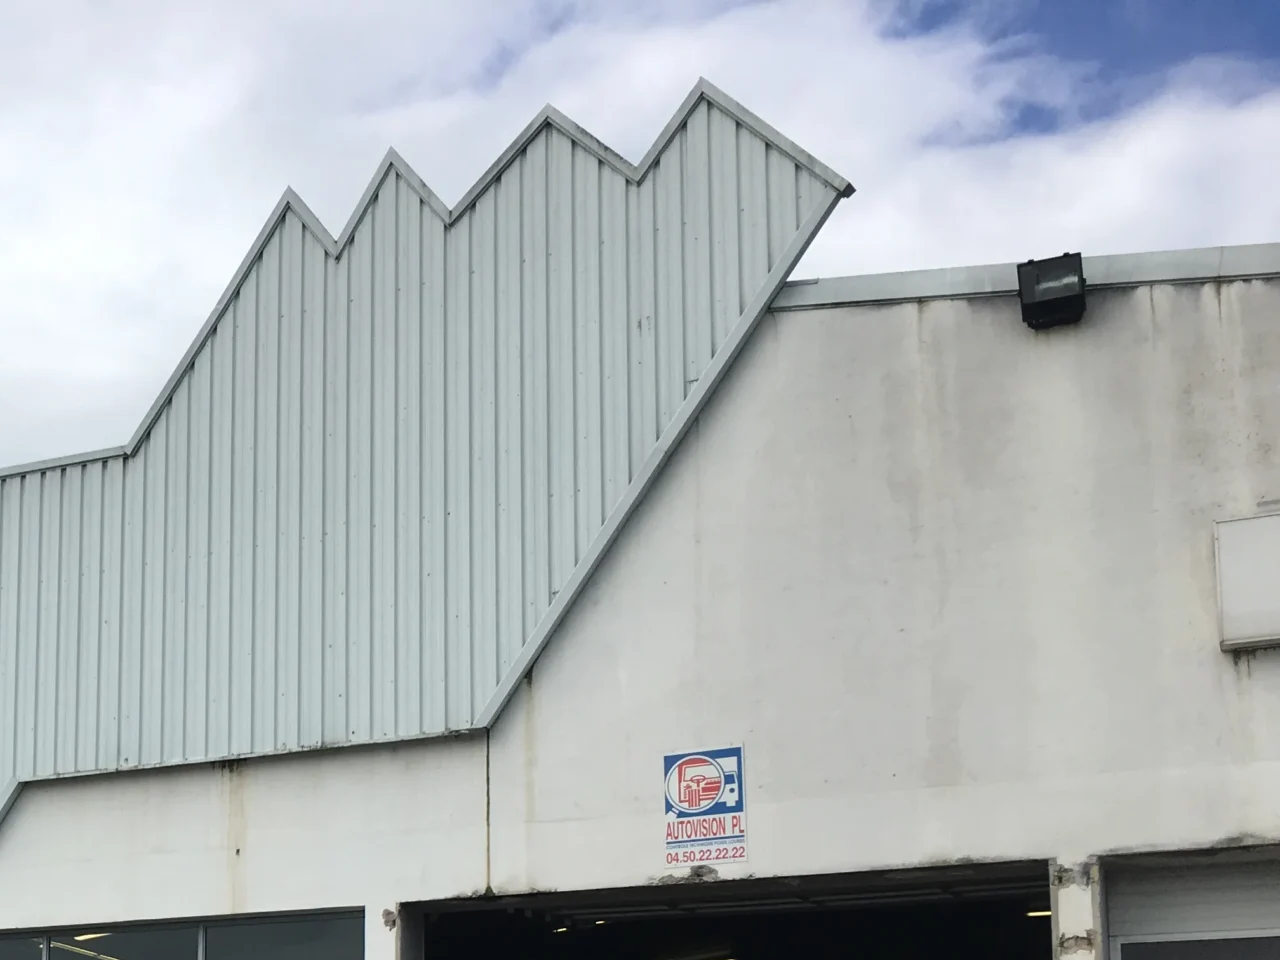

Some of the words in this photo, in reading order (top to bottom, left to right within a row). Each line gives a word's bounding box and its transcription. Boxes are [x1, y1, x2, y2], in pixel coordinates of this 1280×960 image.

[666, 816, 726, 840] AUTOVISION
[731, 815, 745, 834] PL
[666, 846, 745, 864] 04.50.22.22.22
